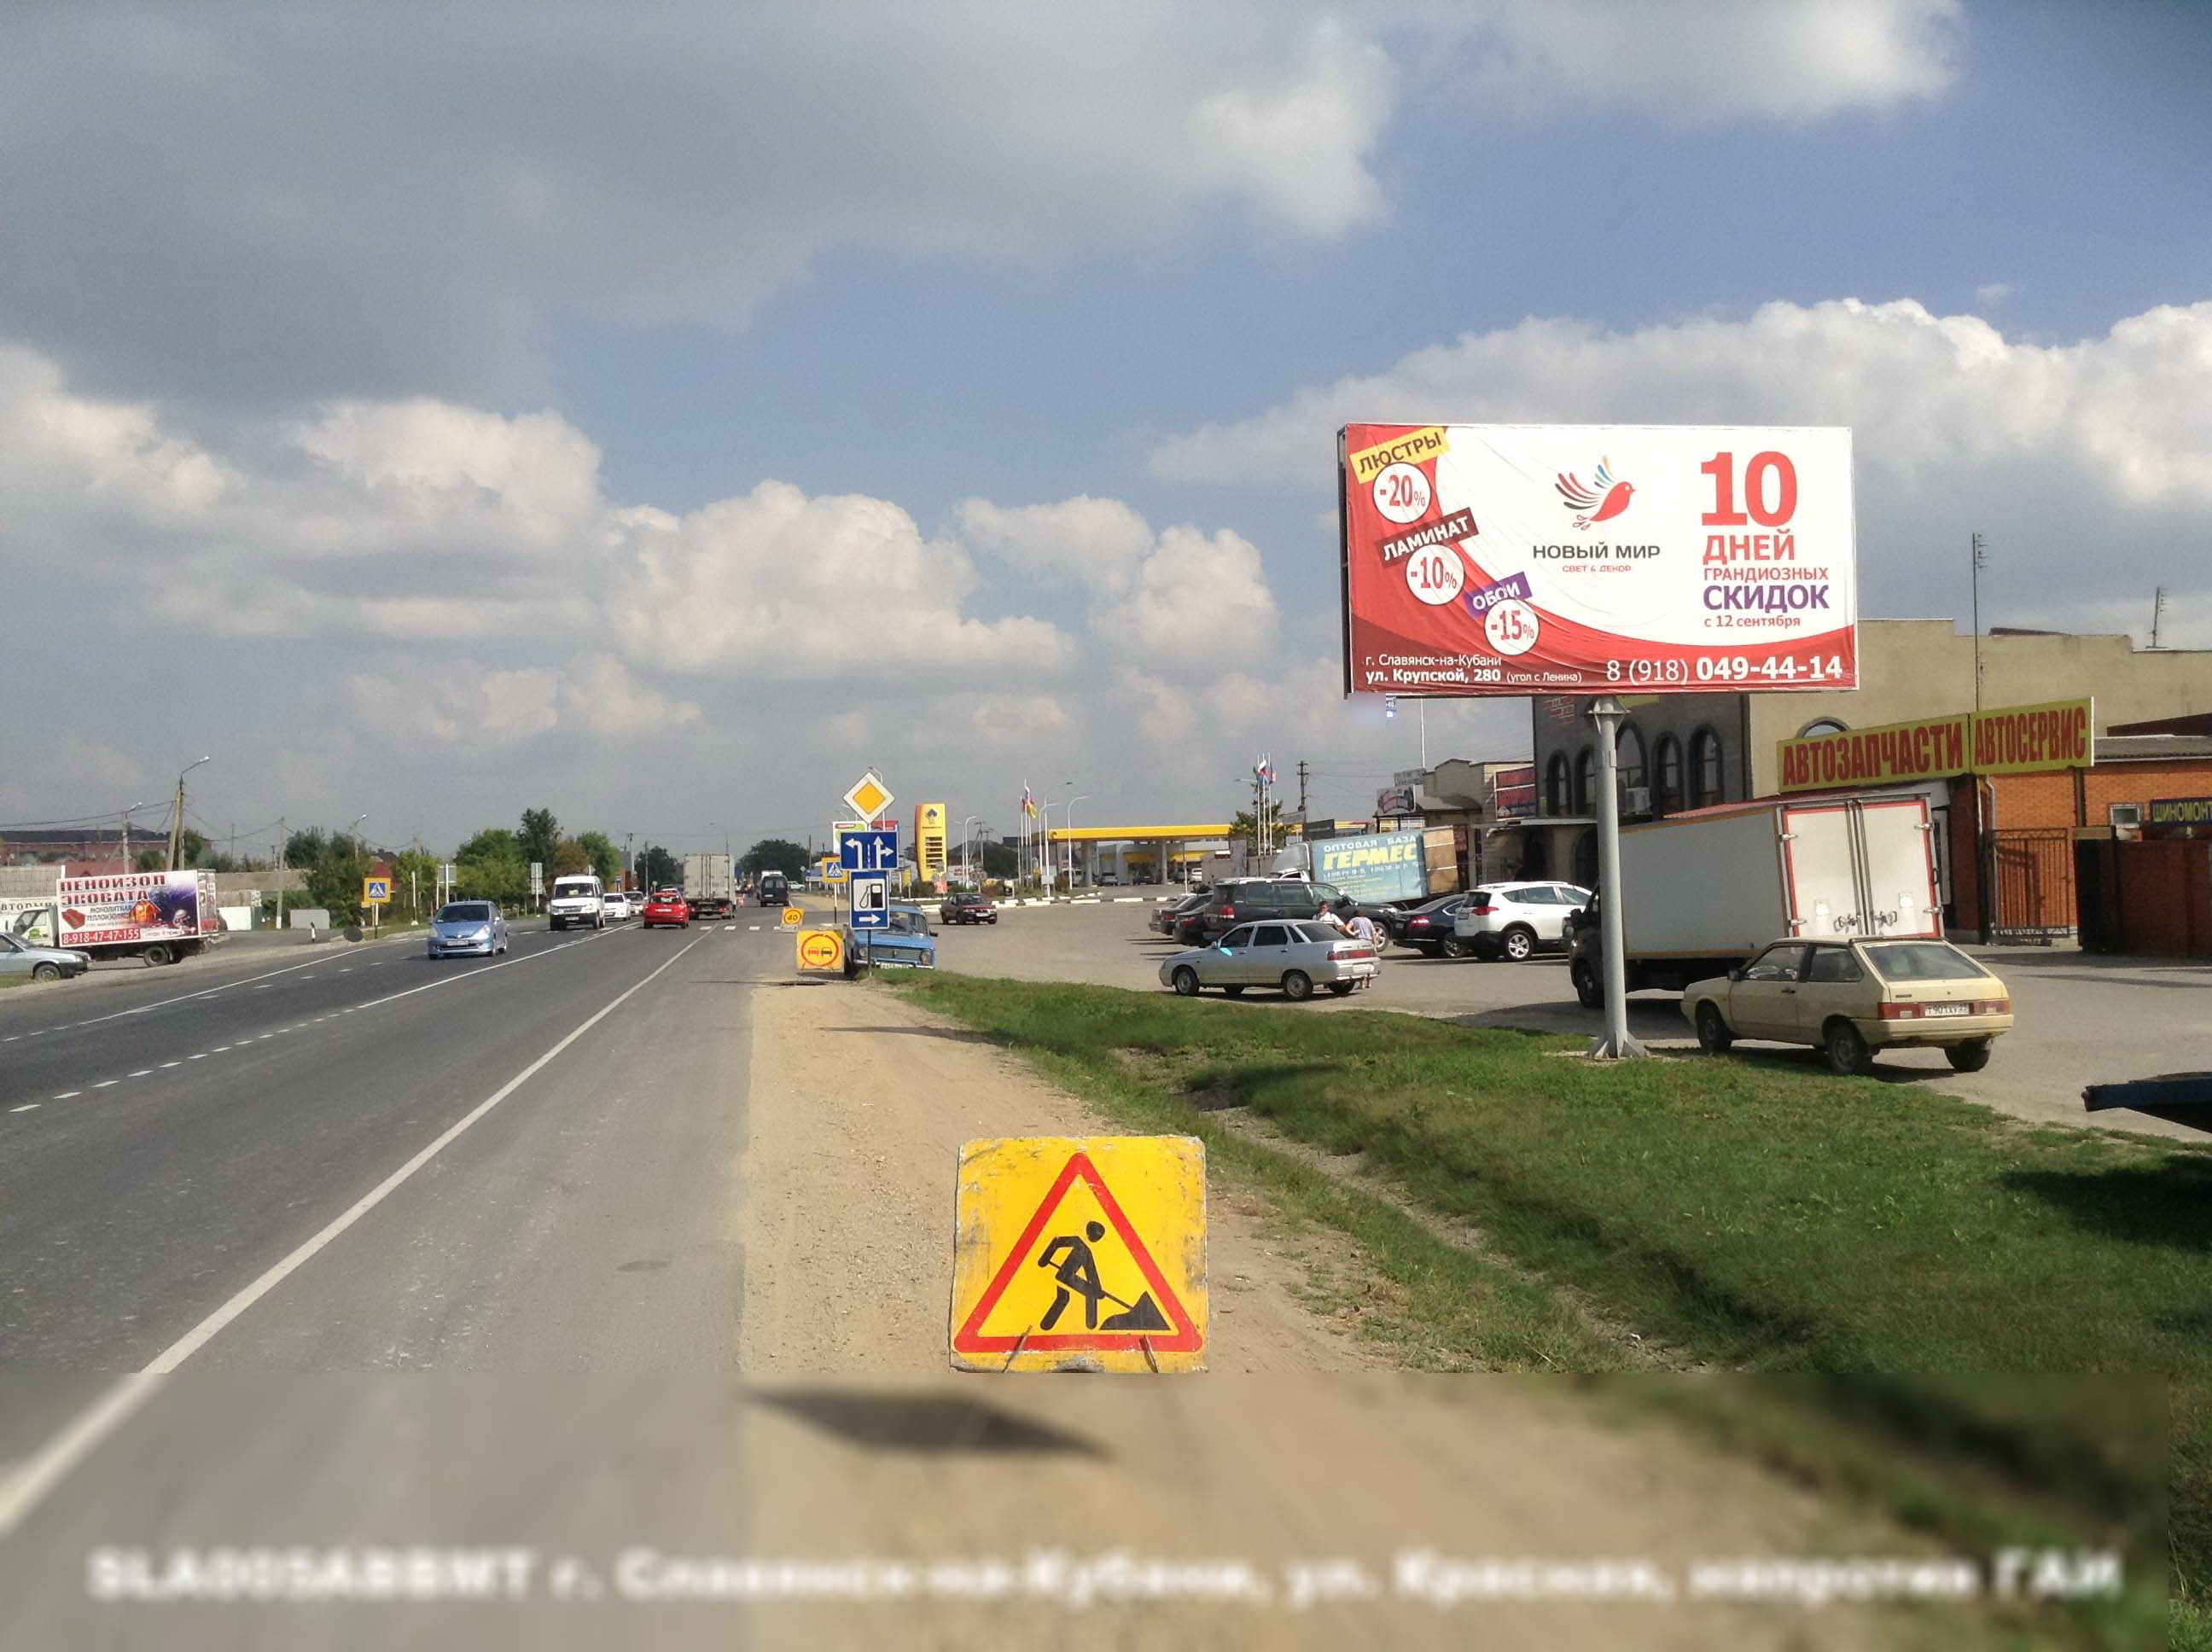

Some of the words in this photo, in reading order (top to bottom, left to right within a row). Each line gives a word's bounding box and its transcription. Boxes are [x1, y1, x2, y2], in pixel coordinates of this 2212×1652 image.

[1359, 432, 1441, 474] ЛЮСТРЫ
[1379, 474, 1426, 507] -20%
[1700, 451, 1797, 527] 10
[1382, 515, 1469, 561] ЛАМИНАТ
[1533, 541, 1609, 559] НОВЫЙ
[1615, 545, 1661, 559] МИР
[1703, 528, 1795, 565] ДНЕЙ
[1411, 556, 1458, 589] -10%
[1703, 567, 1829, 584] ГРАНДИОЗНЫХ
[1472, 581, 1521, 611] ОБОИ
[1703, 585, 1830, 614] СКИДОК
[1491, 610, 1534, 640] -15%
[1704, 617, 1712, 627] с
[1715, 615, 1733, 627] 12
[1737, 614, 1801, 629] сентября
[1365, 656, 1375, 666] г.
[1378, 654, 1502, 669] Славянск-на-Кубани
[1606, 660, 1621, 682] 8
[1628, 659, 1688, 685] (918)
[1696, 655, 1843, 681] 049-44-14
[1365, 671, 1388, 683] ул.
[1393, 668, 1469, 683] Крупской,
[1474, 669, 1501, 682] 280
[1506, 672, 1532, 684] (угол
[1542, 672, 1582, 683] Ленина)
[1783, 722, 1964, 786] АВТОЗАПЧАСТИ
[1974, 706, 2086, 766] АВТОСЕРВИС
[1323, 839, 1377, 852] ОПТОВАЯ
[1387, 835, 1417, 845] БАЗА
[1323, 843, 1417, 870] ГЕРМЕС
[60, 875, 166, 892] ПЕНОИЗОЛ
[61, 890, 150, 905] ЭКОВАТА
[788, 913, 798, 922] 40
[62, 928, 140, 945] 8-918-47-47-155
